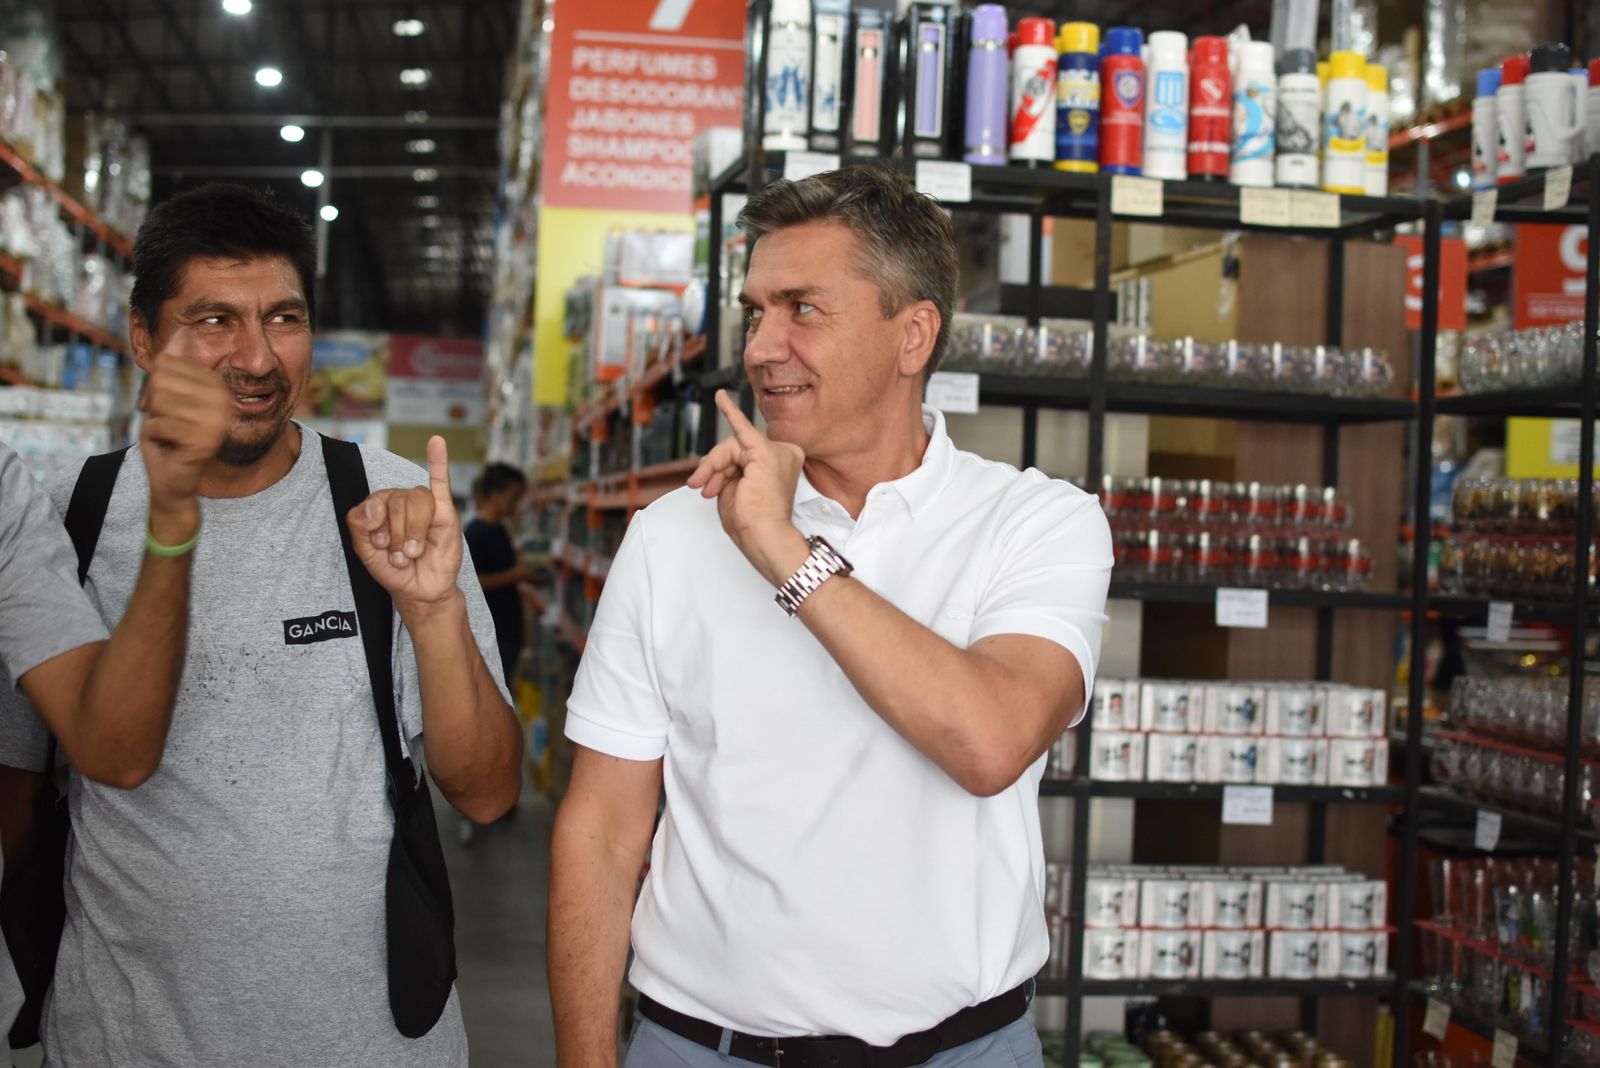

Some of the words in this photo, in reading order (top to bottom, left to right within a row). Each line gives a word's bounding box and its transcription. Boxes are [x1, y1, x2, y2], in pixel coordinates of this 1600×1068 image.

[572, 46, 717, 80] PERFUMES
[567, 106, 695, 137] JABONES
[289, 616, 352, 638] GANCIA
